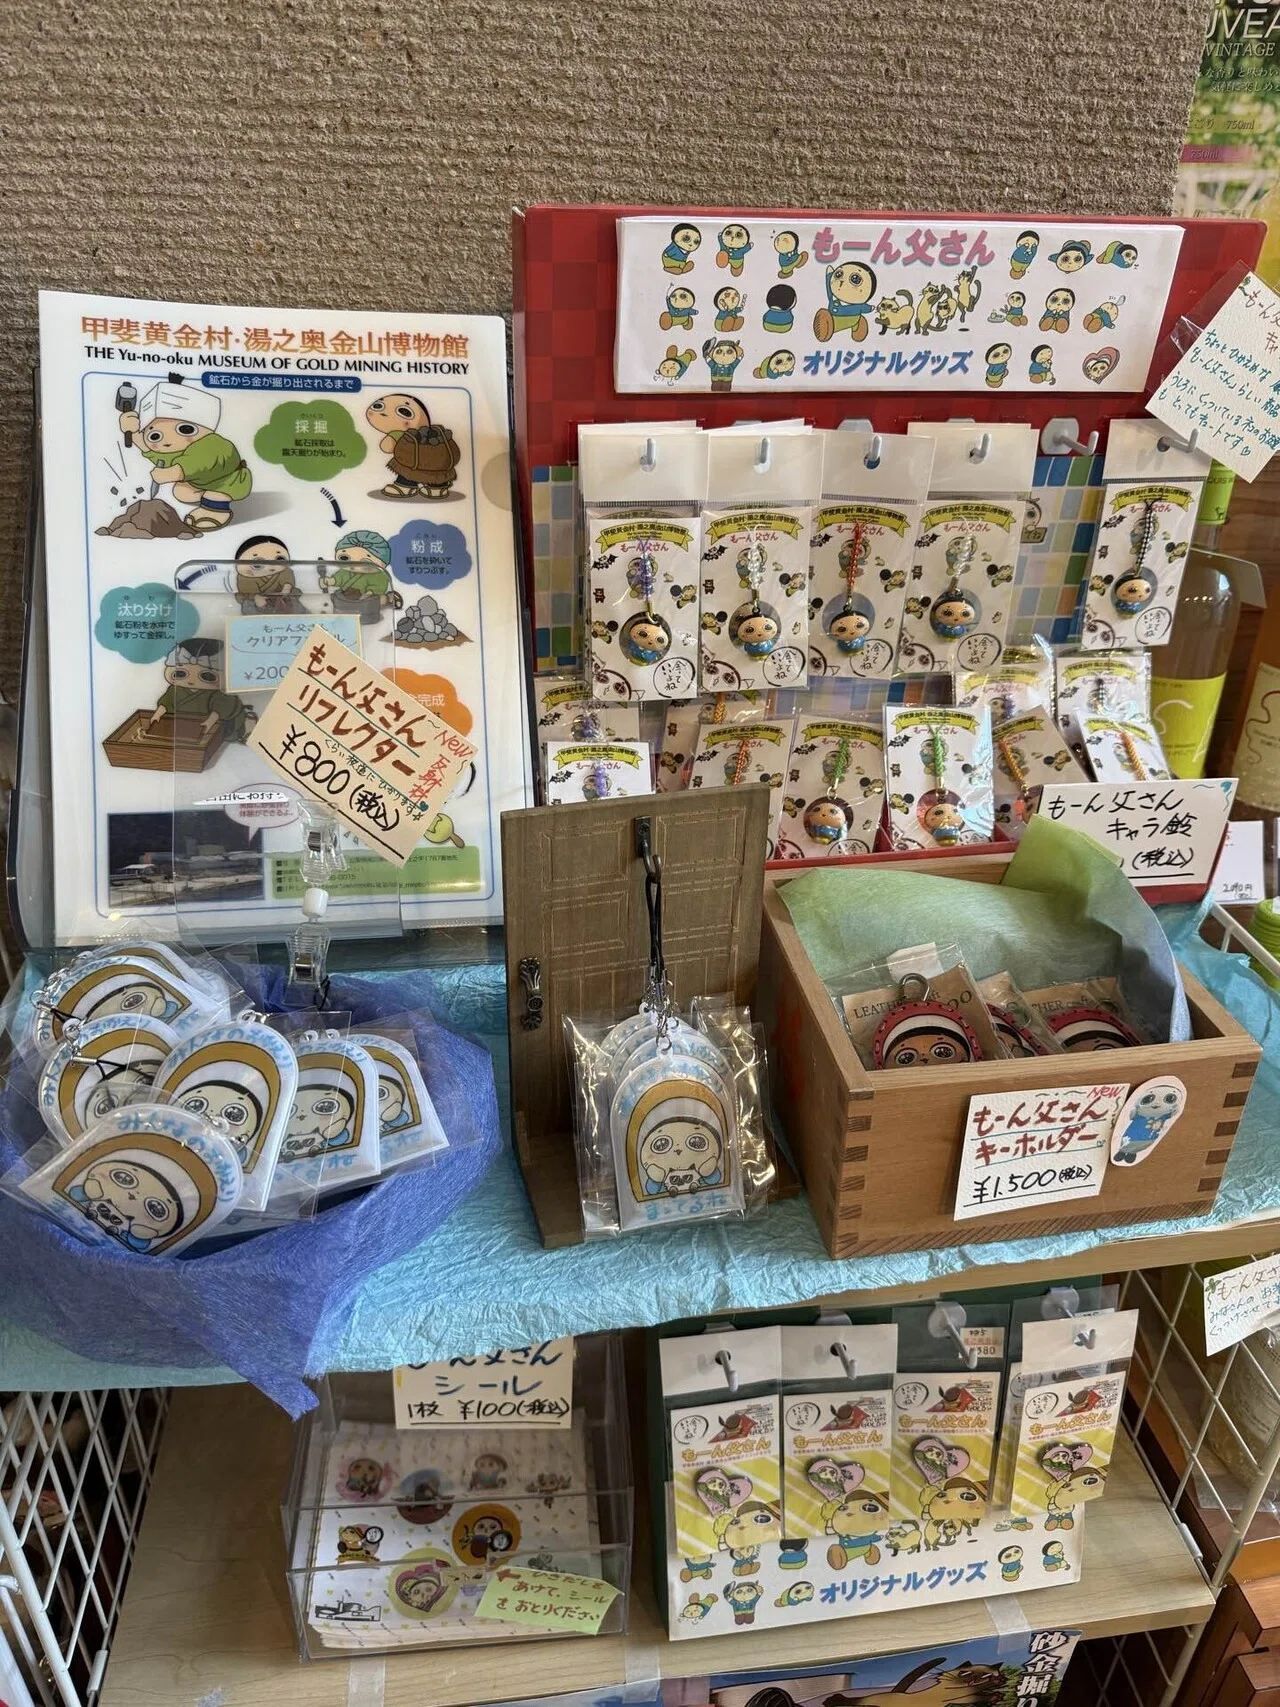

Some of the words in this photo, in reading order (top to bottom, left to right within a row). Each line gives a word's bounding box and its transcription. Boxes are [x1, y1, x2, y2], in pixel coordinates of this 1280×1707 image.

[1204, 43, 1276, 57] VINTAGE
[812, 226, 995, 266] もーん父さん
[84, 346, 115, 359] THE
[118, 349, 193, 365] Yu-no-oku
[198, 355, 267, 369] MUSEUM
[271, 357, 292, 370] OF
[296, 358, 339, 371] GOLD
[344, 359, 402, 373] MINING
[407, 361, 469, 375] HISTORY
[803, 350, 973, 376] オリジナルグッズ
[209, 374, 354, 389] 鉱石から金が掘り出されるまで
[308, 643, 427, 748] もーん父さん
[299, 684, 416, 777] リフレクター
[1048, 789, 1185, 820] もーん父さん
[1106, 812, 1198, 841] キャラ鈴
[972, 1095, 1109, 1136] もーん父さん
[974, 1122, 1100, 1166] キーホルダー
[435, 1375, 543, 1396] シール
[407, 1401, 444, 1418] 1枚
[819, 1560, 988, 1604] オリジナルグッズ
